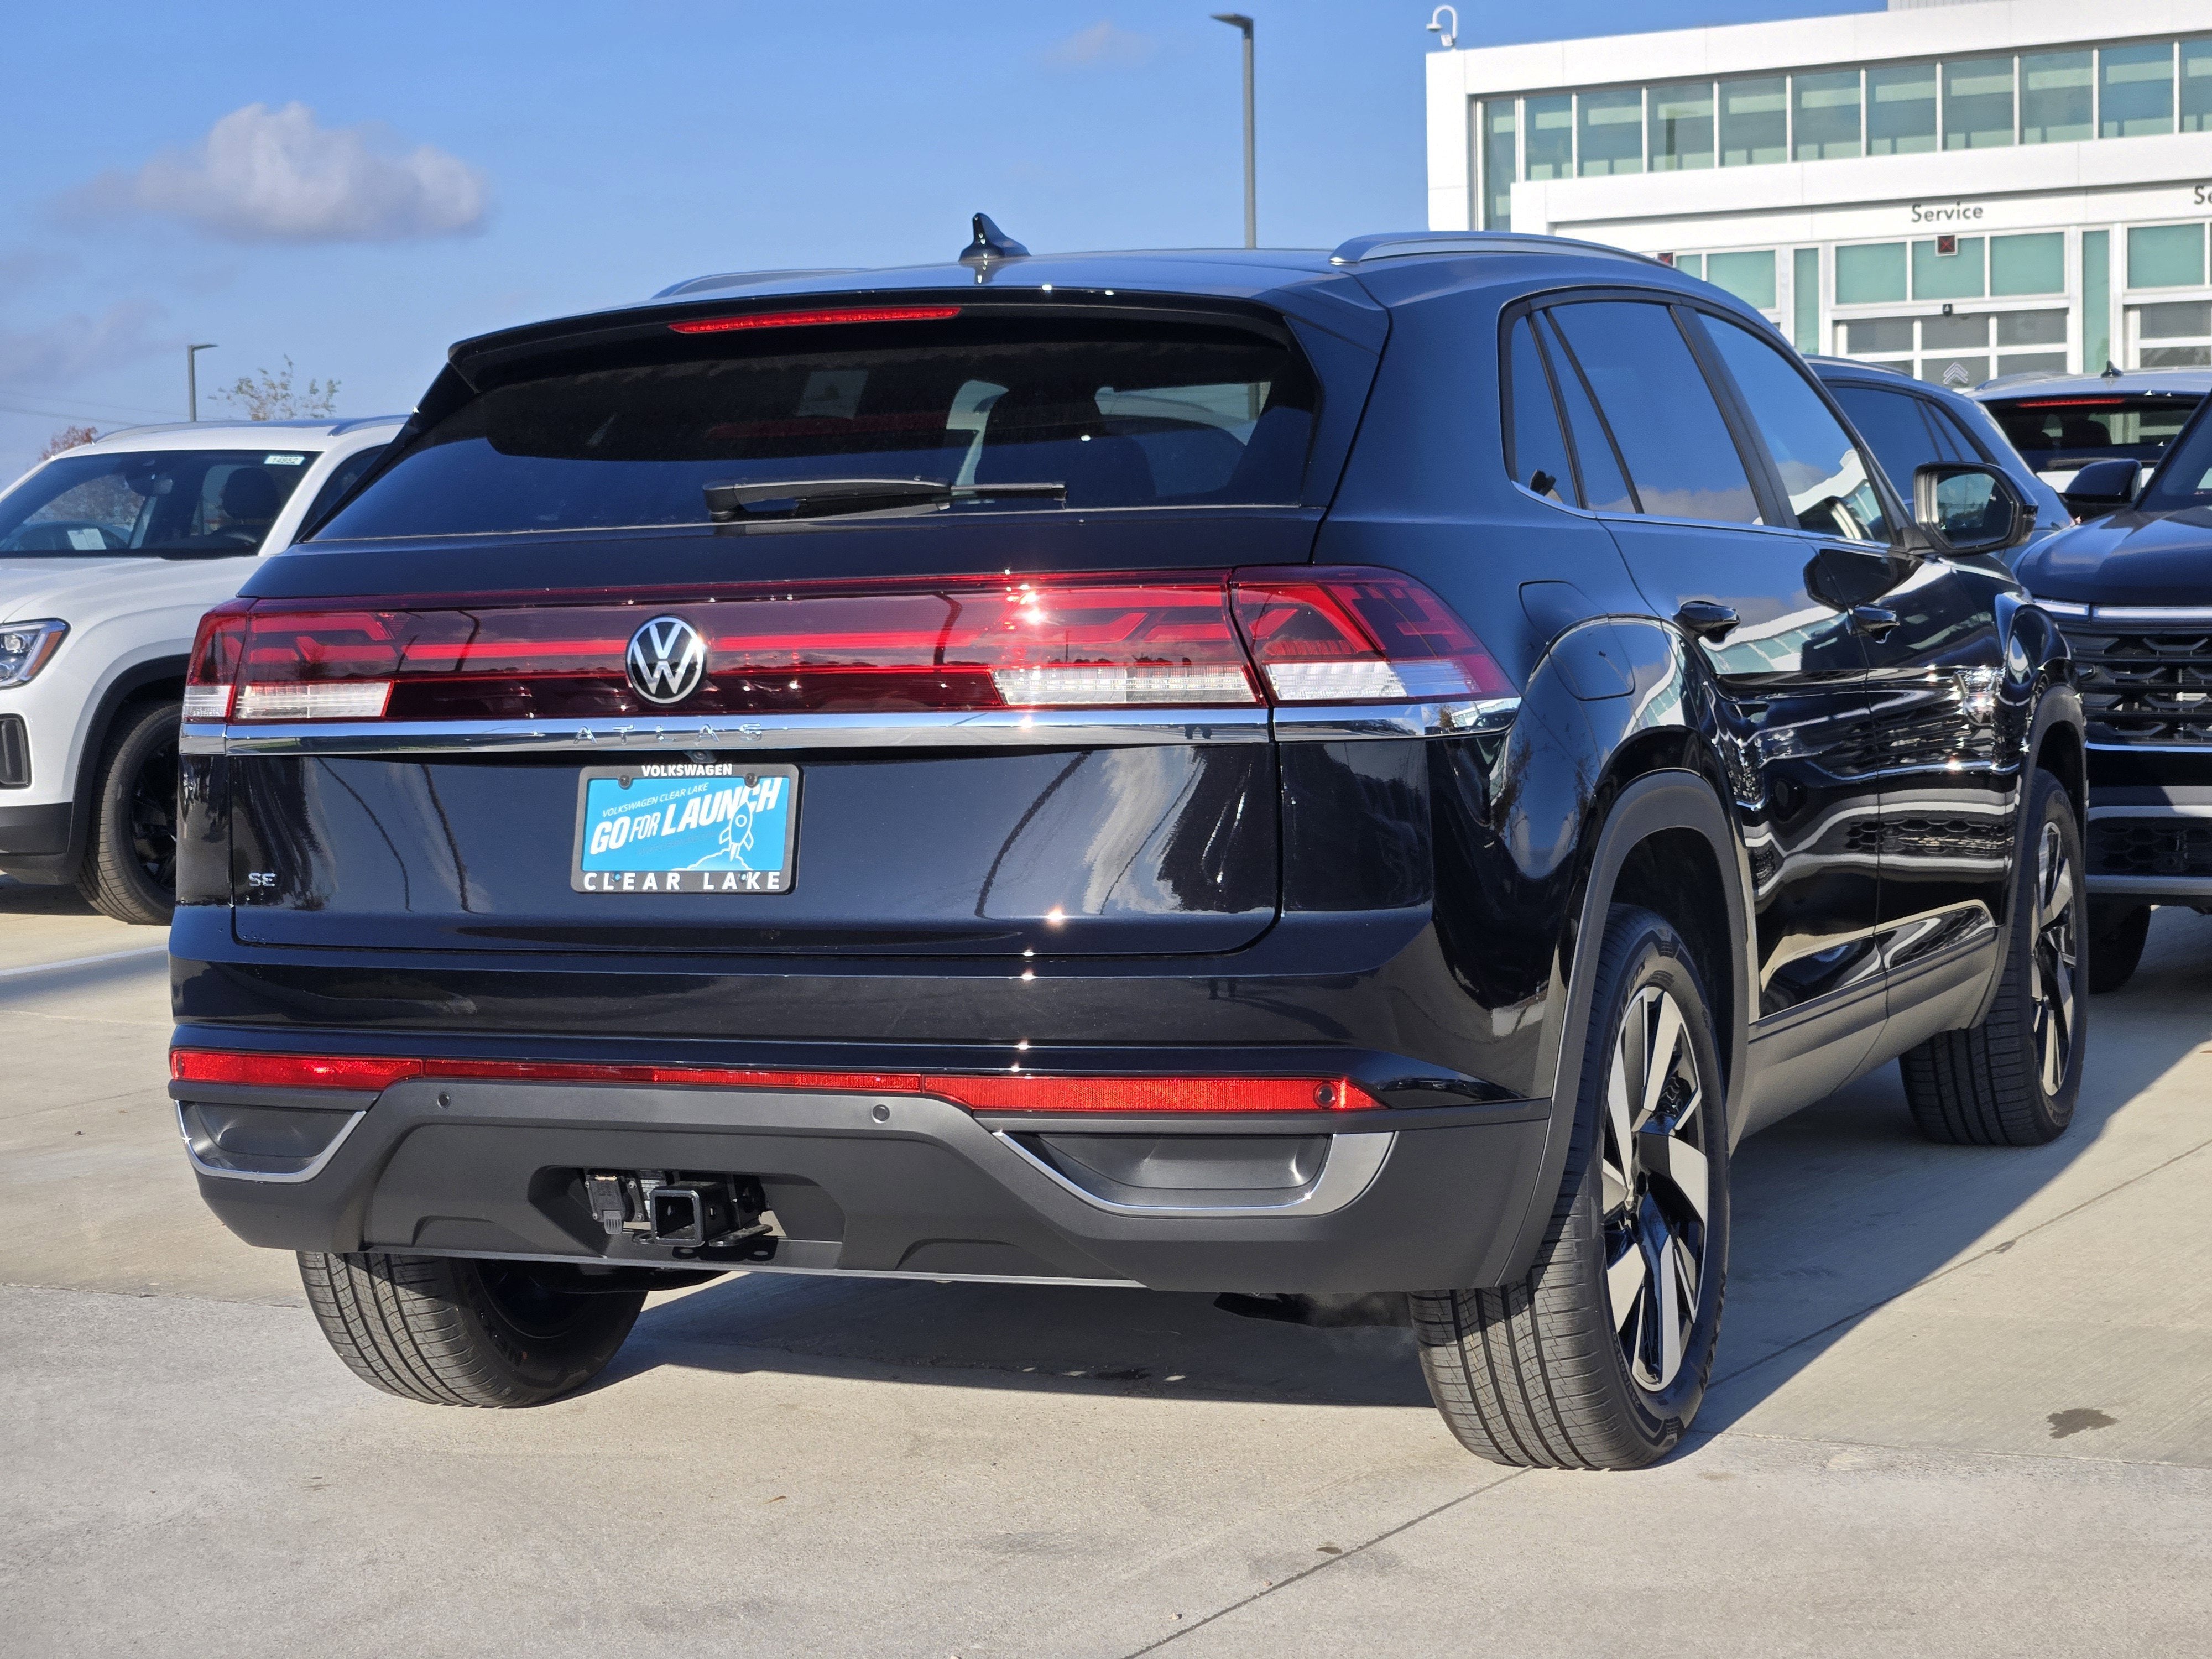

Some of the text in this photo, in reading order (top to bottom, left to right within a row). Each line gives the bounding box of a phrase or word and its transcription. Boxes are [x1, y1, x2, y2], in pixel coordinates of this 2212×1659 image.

[1911, 201, 1983, 223] Service
[573, 723, 763, 744] ATLAS
[641, 764, 733, 777] VOLKSWAGEN
[603, 782, 709, 817] VOLKSWAGEN CLEAR LAKE
[590, 778, 782, 855] GO FOR LAUNCH
[248, 873, 276, 887] SE
[583, 872, 780, 890] CLEAR LAKE
